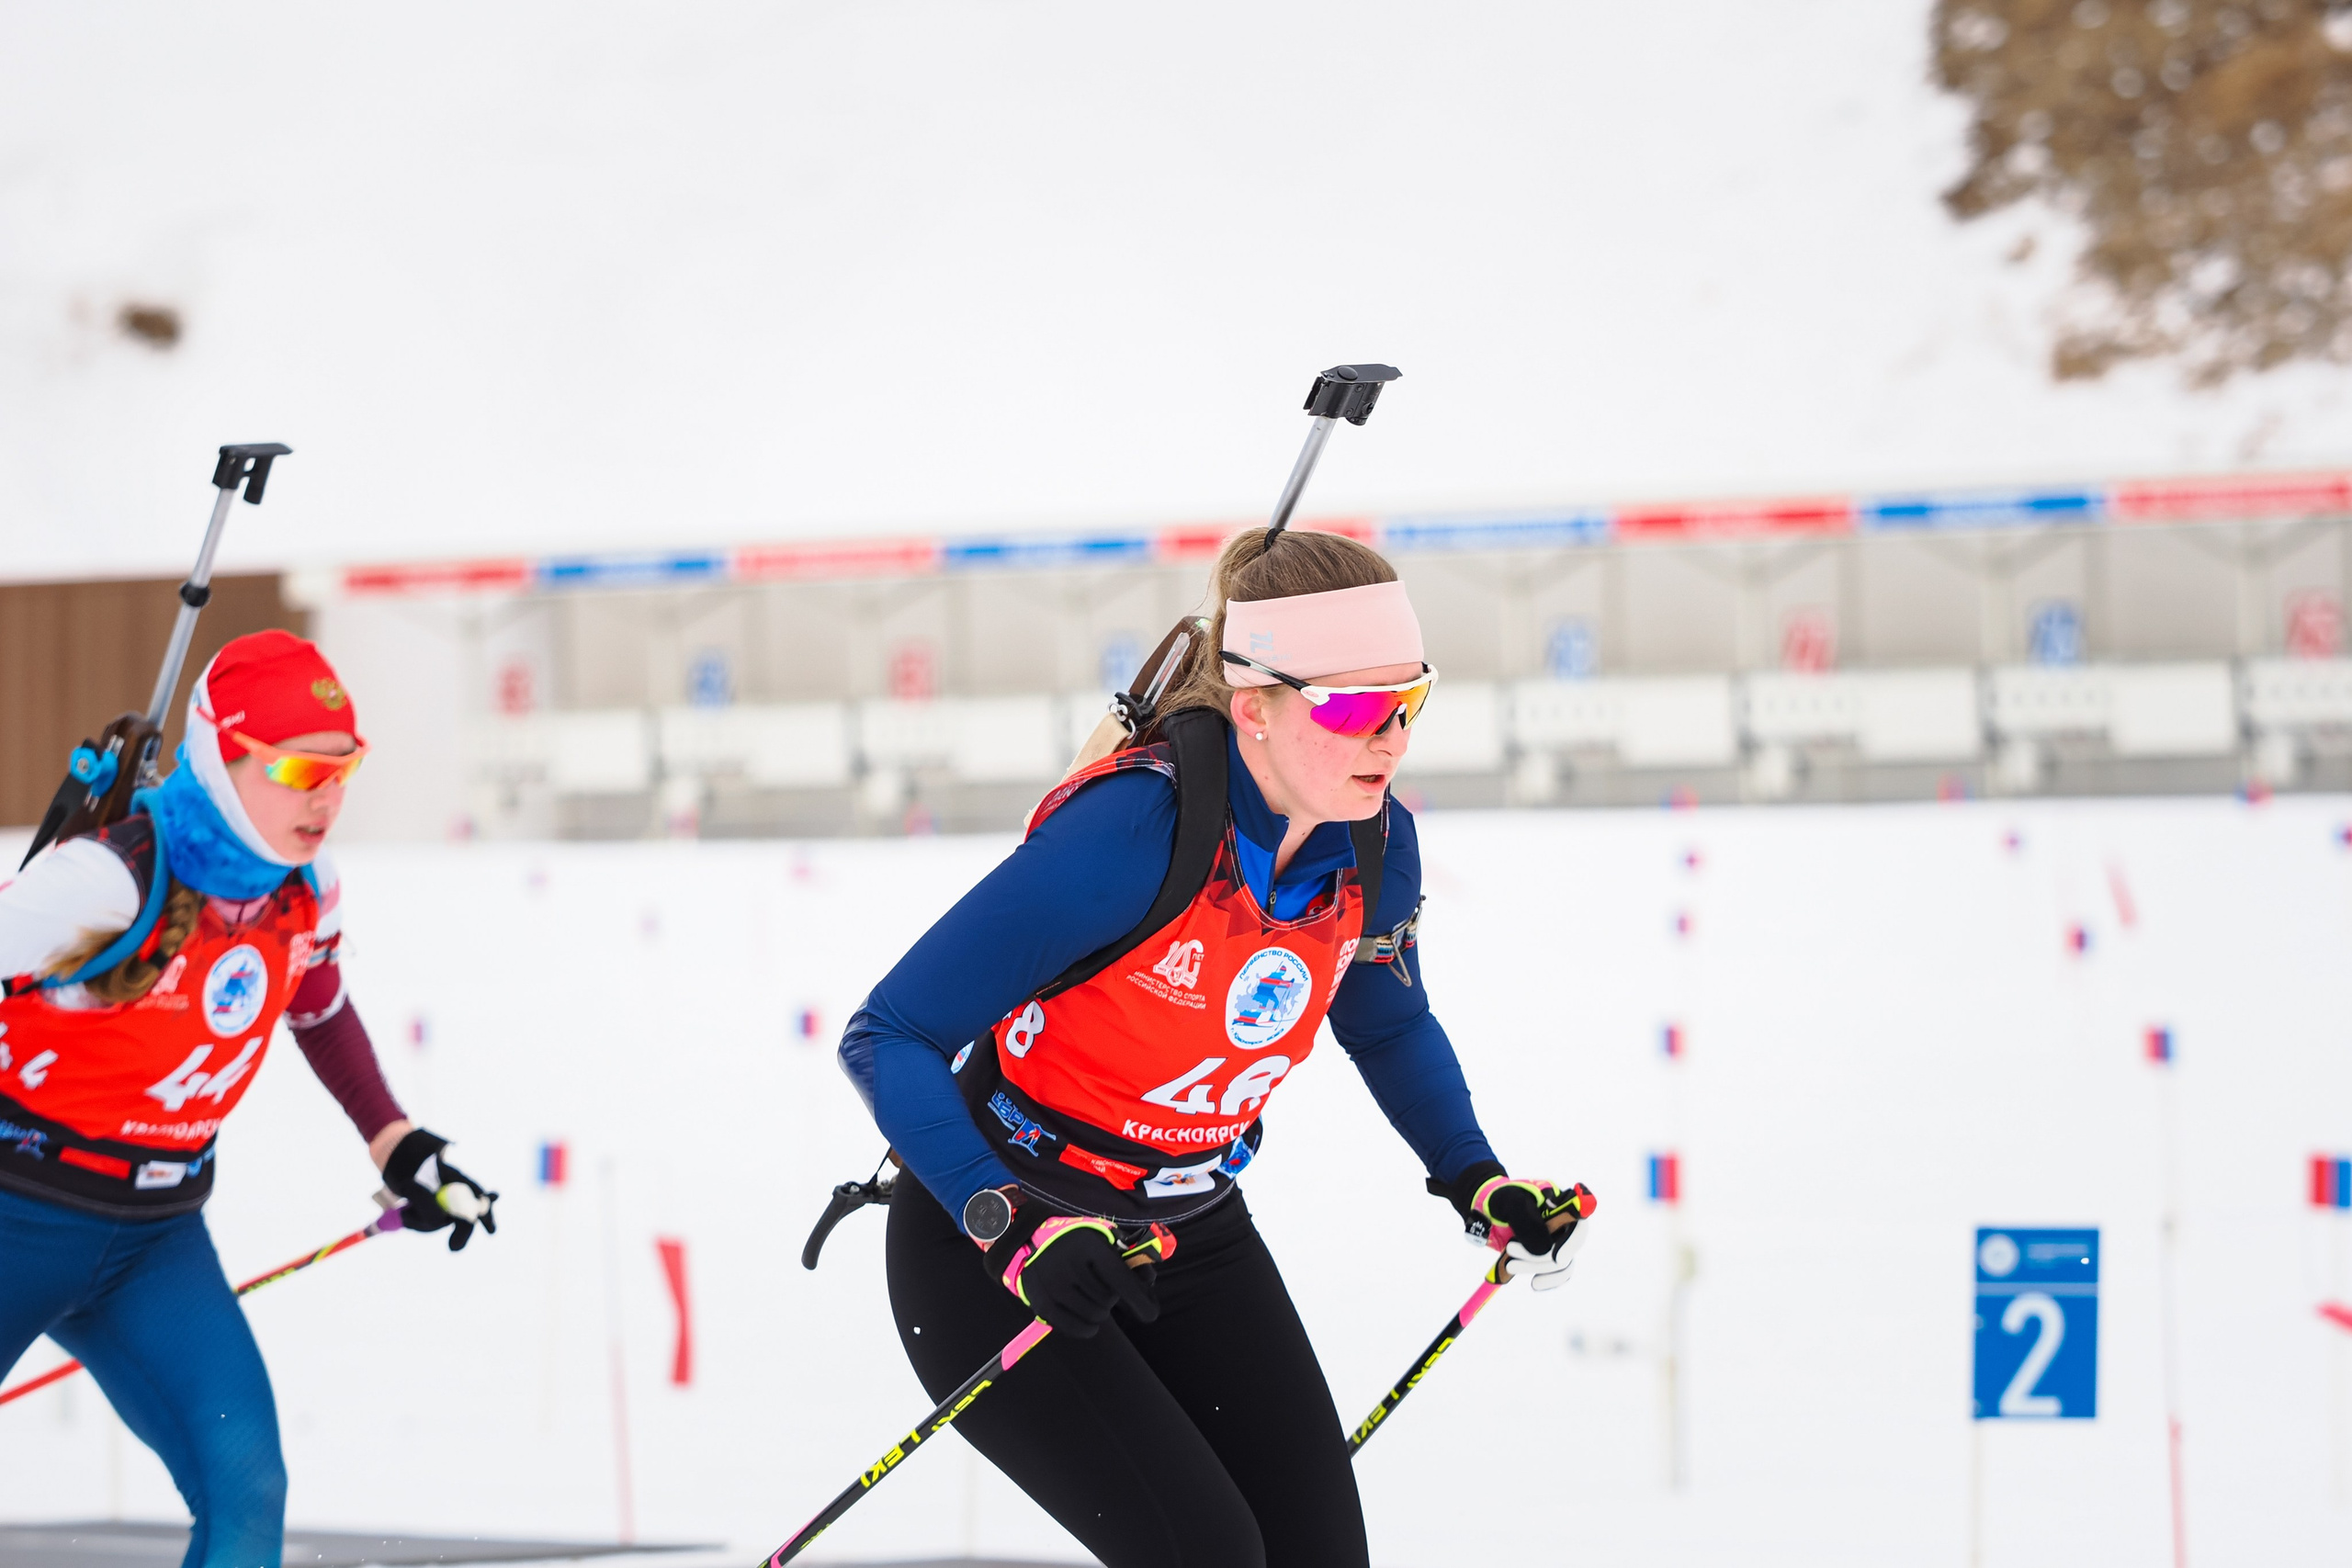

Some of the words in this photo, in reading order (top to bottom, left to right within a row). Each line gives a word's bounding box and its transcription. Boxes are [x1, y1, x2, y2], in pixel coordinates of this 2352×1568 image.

[1133, 971, 1183, 998] МИНИСТЕРСТВО
[1183, 992, 1205, 1002] СПОРТА
[1238, 950, 1283, 980] ПЕРВЕНСТВО
[1283, 952, 1308, 982] РОССИИ
[1002, 999, 1046, 1059] 8
[1167, 995, 1206, 1010] ФЕДЕРАЦИИ
[143, 1035, 264, 1111] 44
[1139, 1055, 1292, 1115] 48
[1998, 1291, 2065, 1417] 2
[860, 1427, 922, 1488] LEKI
